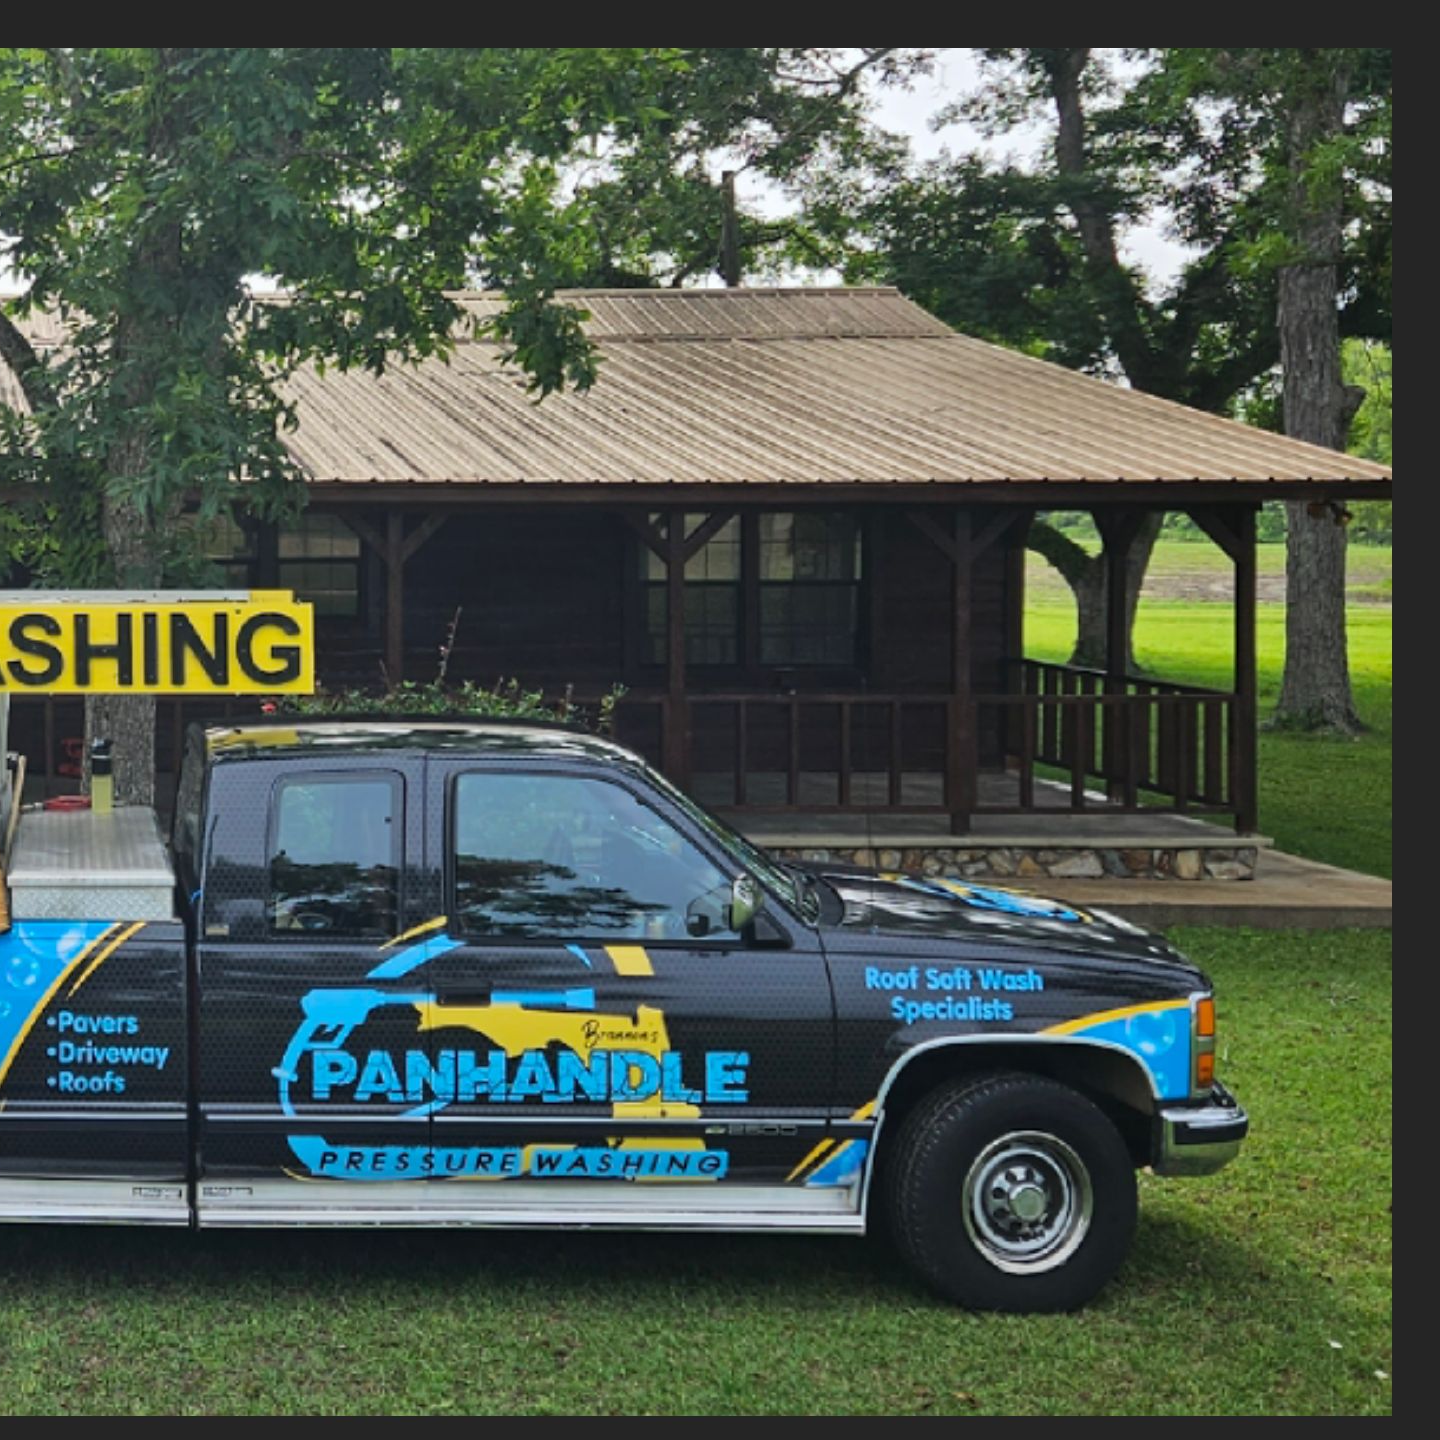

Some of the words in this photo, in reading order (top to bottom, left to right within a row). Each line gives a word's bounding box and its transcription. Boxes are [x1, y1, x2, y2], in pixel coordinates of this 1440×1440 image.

[865, 966, 918, 990] Roof
[925, 967, 972, 990] Soft
[978, 968, 1044, 991] Wash
[58, 1010, 139, 1034] Pavers
[891, 996, 1013, 1025] Specialists
[58, 1039, 169, 1070] Driveway
[58, 1070, 127, 1093] Roofs
[312, 1050, 750, 1103] PANHANDLE
[319, 1151, 517, 1173] PRESSURE
[536, 1152, 721, 1174] WASHING
